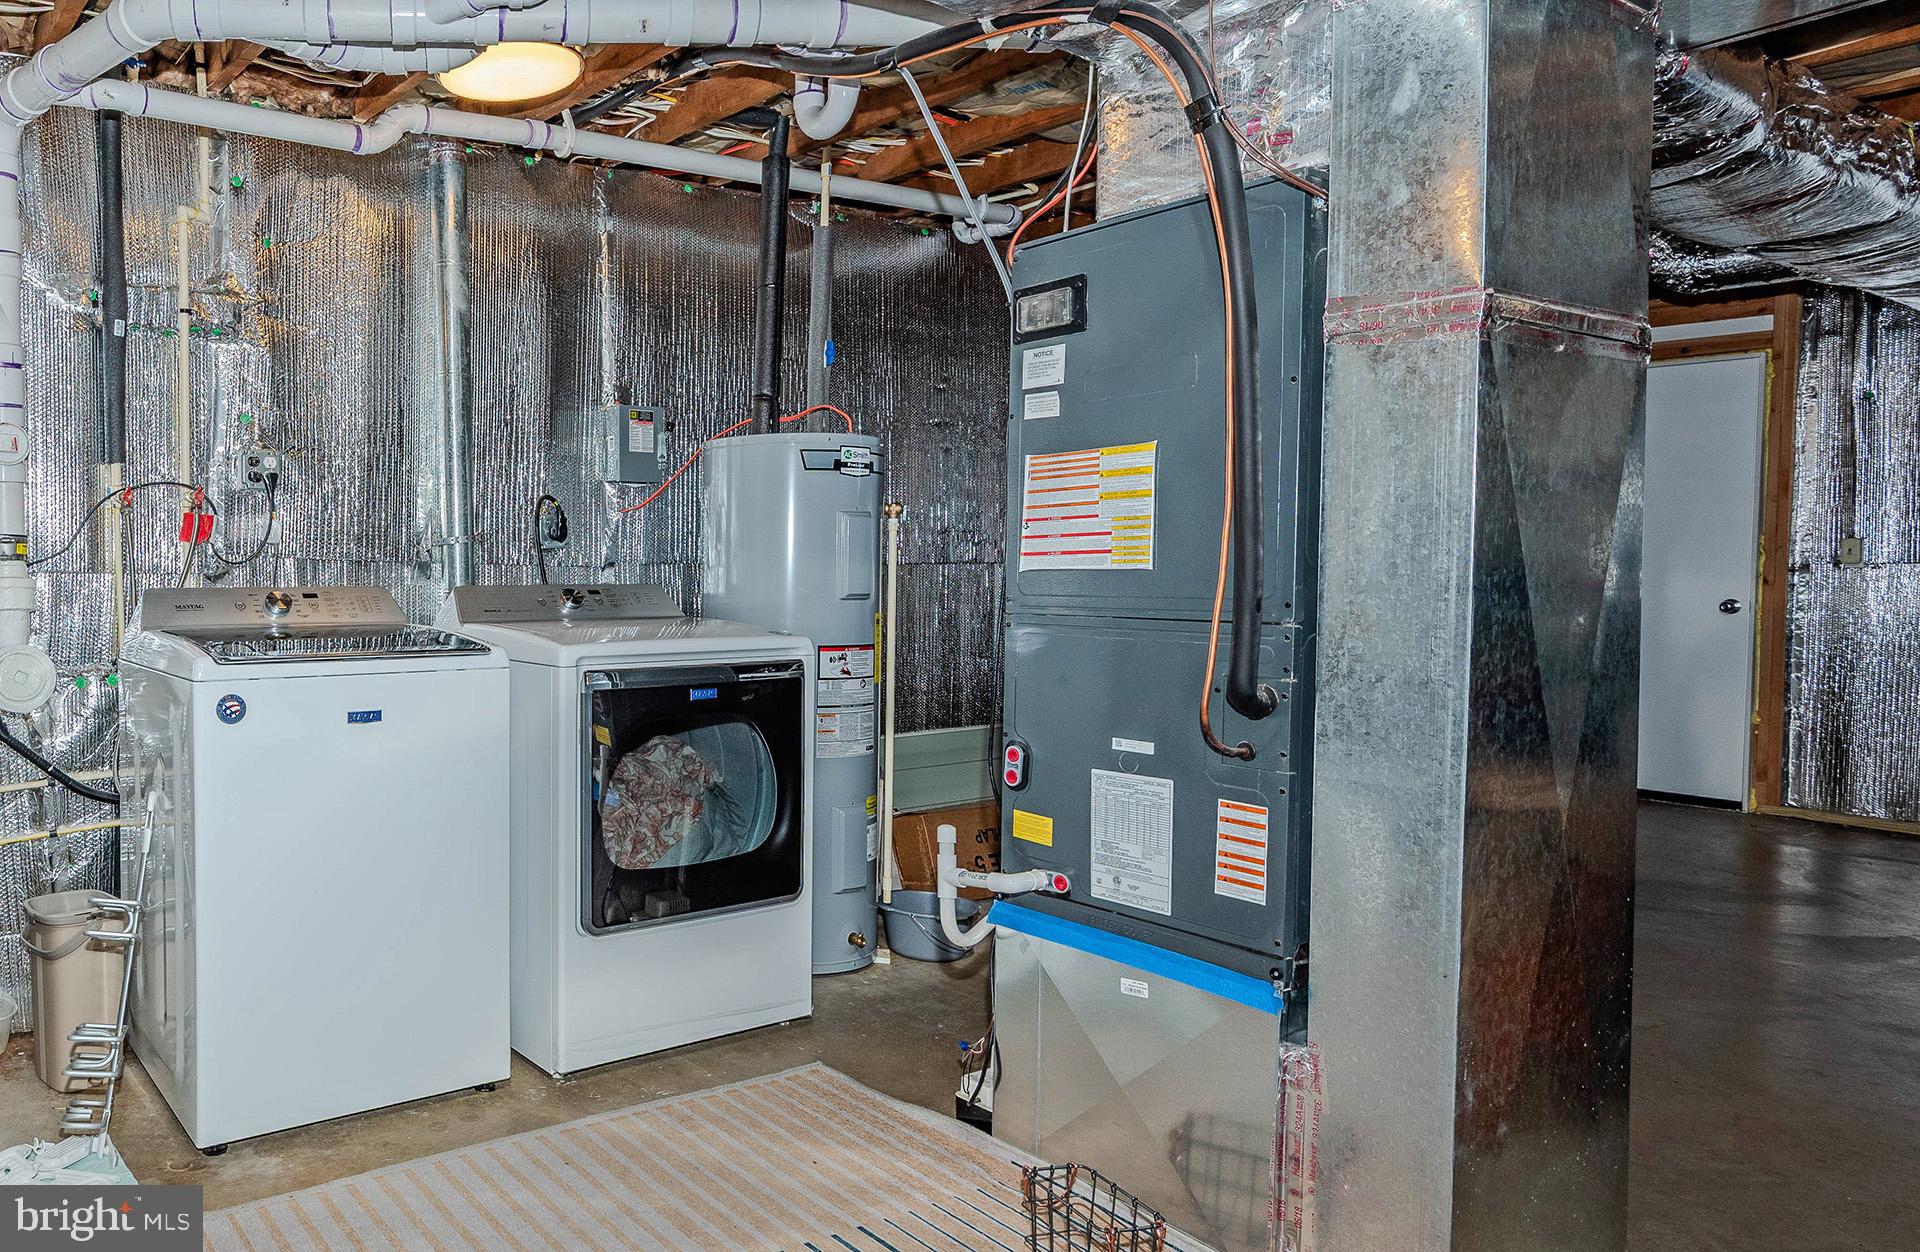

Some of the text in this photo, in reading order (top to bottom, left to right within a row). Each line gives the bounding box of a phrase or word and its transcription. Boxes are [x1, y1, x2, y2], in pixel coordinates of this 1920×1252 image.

[1359, 320, 1384, 331] 06/18
[1034, 350, 1054, 358] NOTICE
[1294, 1205, 1302, 1232] 06/18
